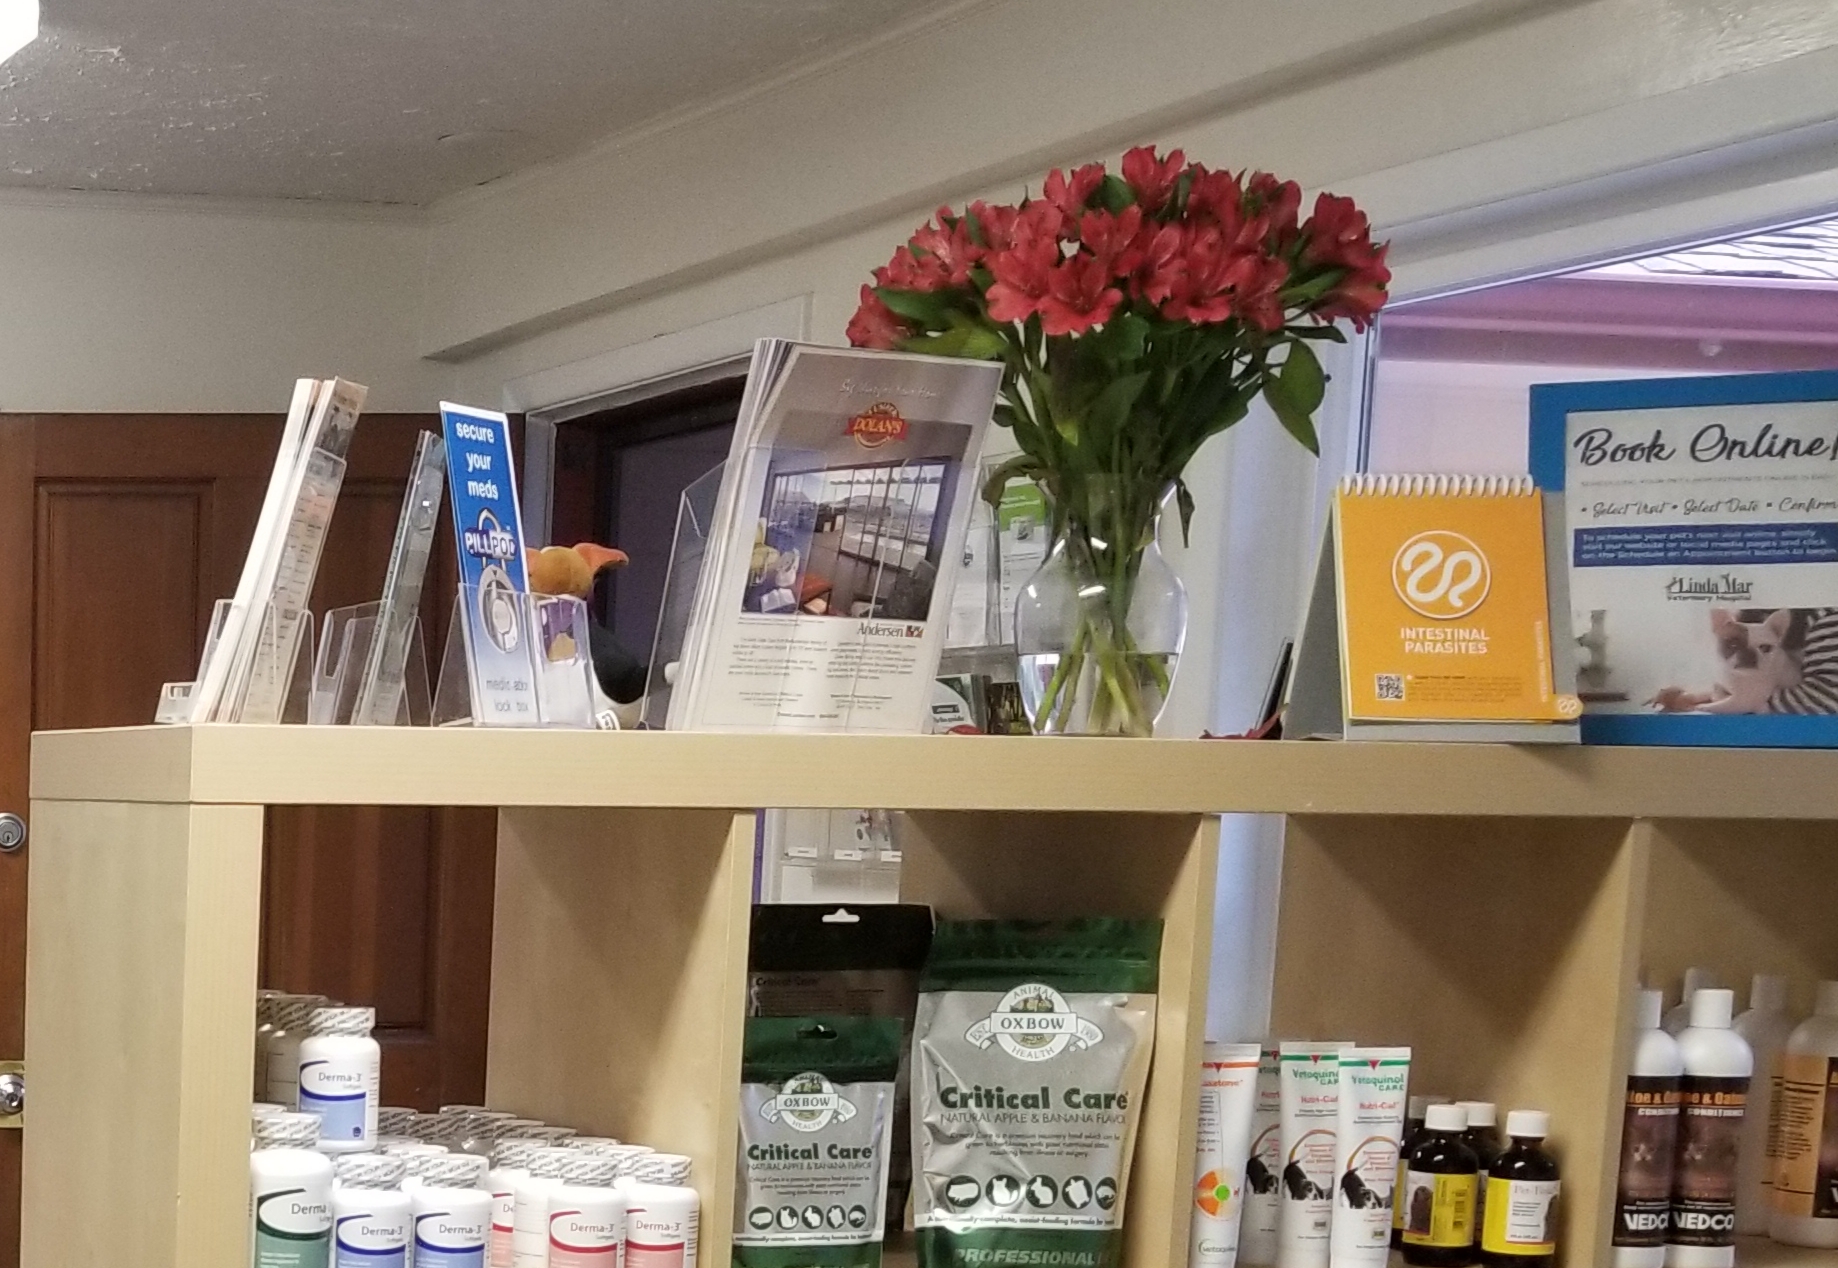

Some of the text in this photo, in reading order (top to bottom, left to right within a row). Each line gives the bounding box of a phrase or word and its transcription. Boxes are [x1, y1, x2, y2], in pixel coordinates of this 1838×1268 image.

[455, 420, 495, 444] secure
[1573, 428, 1676, 466] Book
[466, 452, 492, 473] your
[467, 479, 499, 501] meds
[1593, 502, 1628, 518] Select
[1683, 499, 1719, 515] Select
[1678, 576, 1719, 594] Linda
[857, 622, 904, 637] Andersen
[1400, 627, 1491, 641] INTESTINAL
[1404, 641, 1488, 655] PARASITES
[1012, 985, 1055, 1000] ANIMAL
[1000, 1017, 1065, 1030] OXBOW
[1011, 1045, 1055, 1059] HEALTH
[318, 1072, 362, 1083] Derma-3
[1292, 1068, 1339, 1081] Vetoquin
[1352, 1073, 1404, 1087] Vetoquinol
[1378, 1084, 1404, 1092] CARE
[783, 1096, 831, 1107] OXBOW
[939, 1084, 1129, 1110] Critical Care
[1630, 1090, 1651, 1104] loe
[792, 1119, 823, 1130] HEALTH
[940, 1112, 1126, 1124] NATURAL APPLE & BANANA FLAVO
[747, 1142, 873, 1161] Critical Care
[291, 1203, 327, 1215] Derma
[570, 1222, 615, 1233] Derma-3
[636, 1219, 683, 1231] Derma-3
[1623, 1212, 1670, 1231] VEDC
[1673, 1211, 1735, 1231] VEDCO
[361, 1225, 404, 1237] Derma-3
[438, 1223, 483, 1235] Derma-3
[955, 1248, 1096, 1266] PROFESSIONAL
